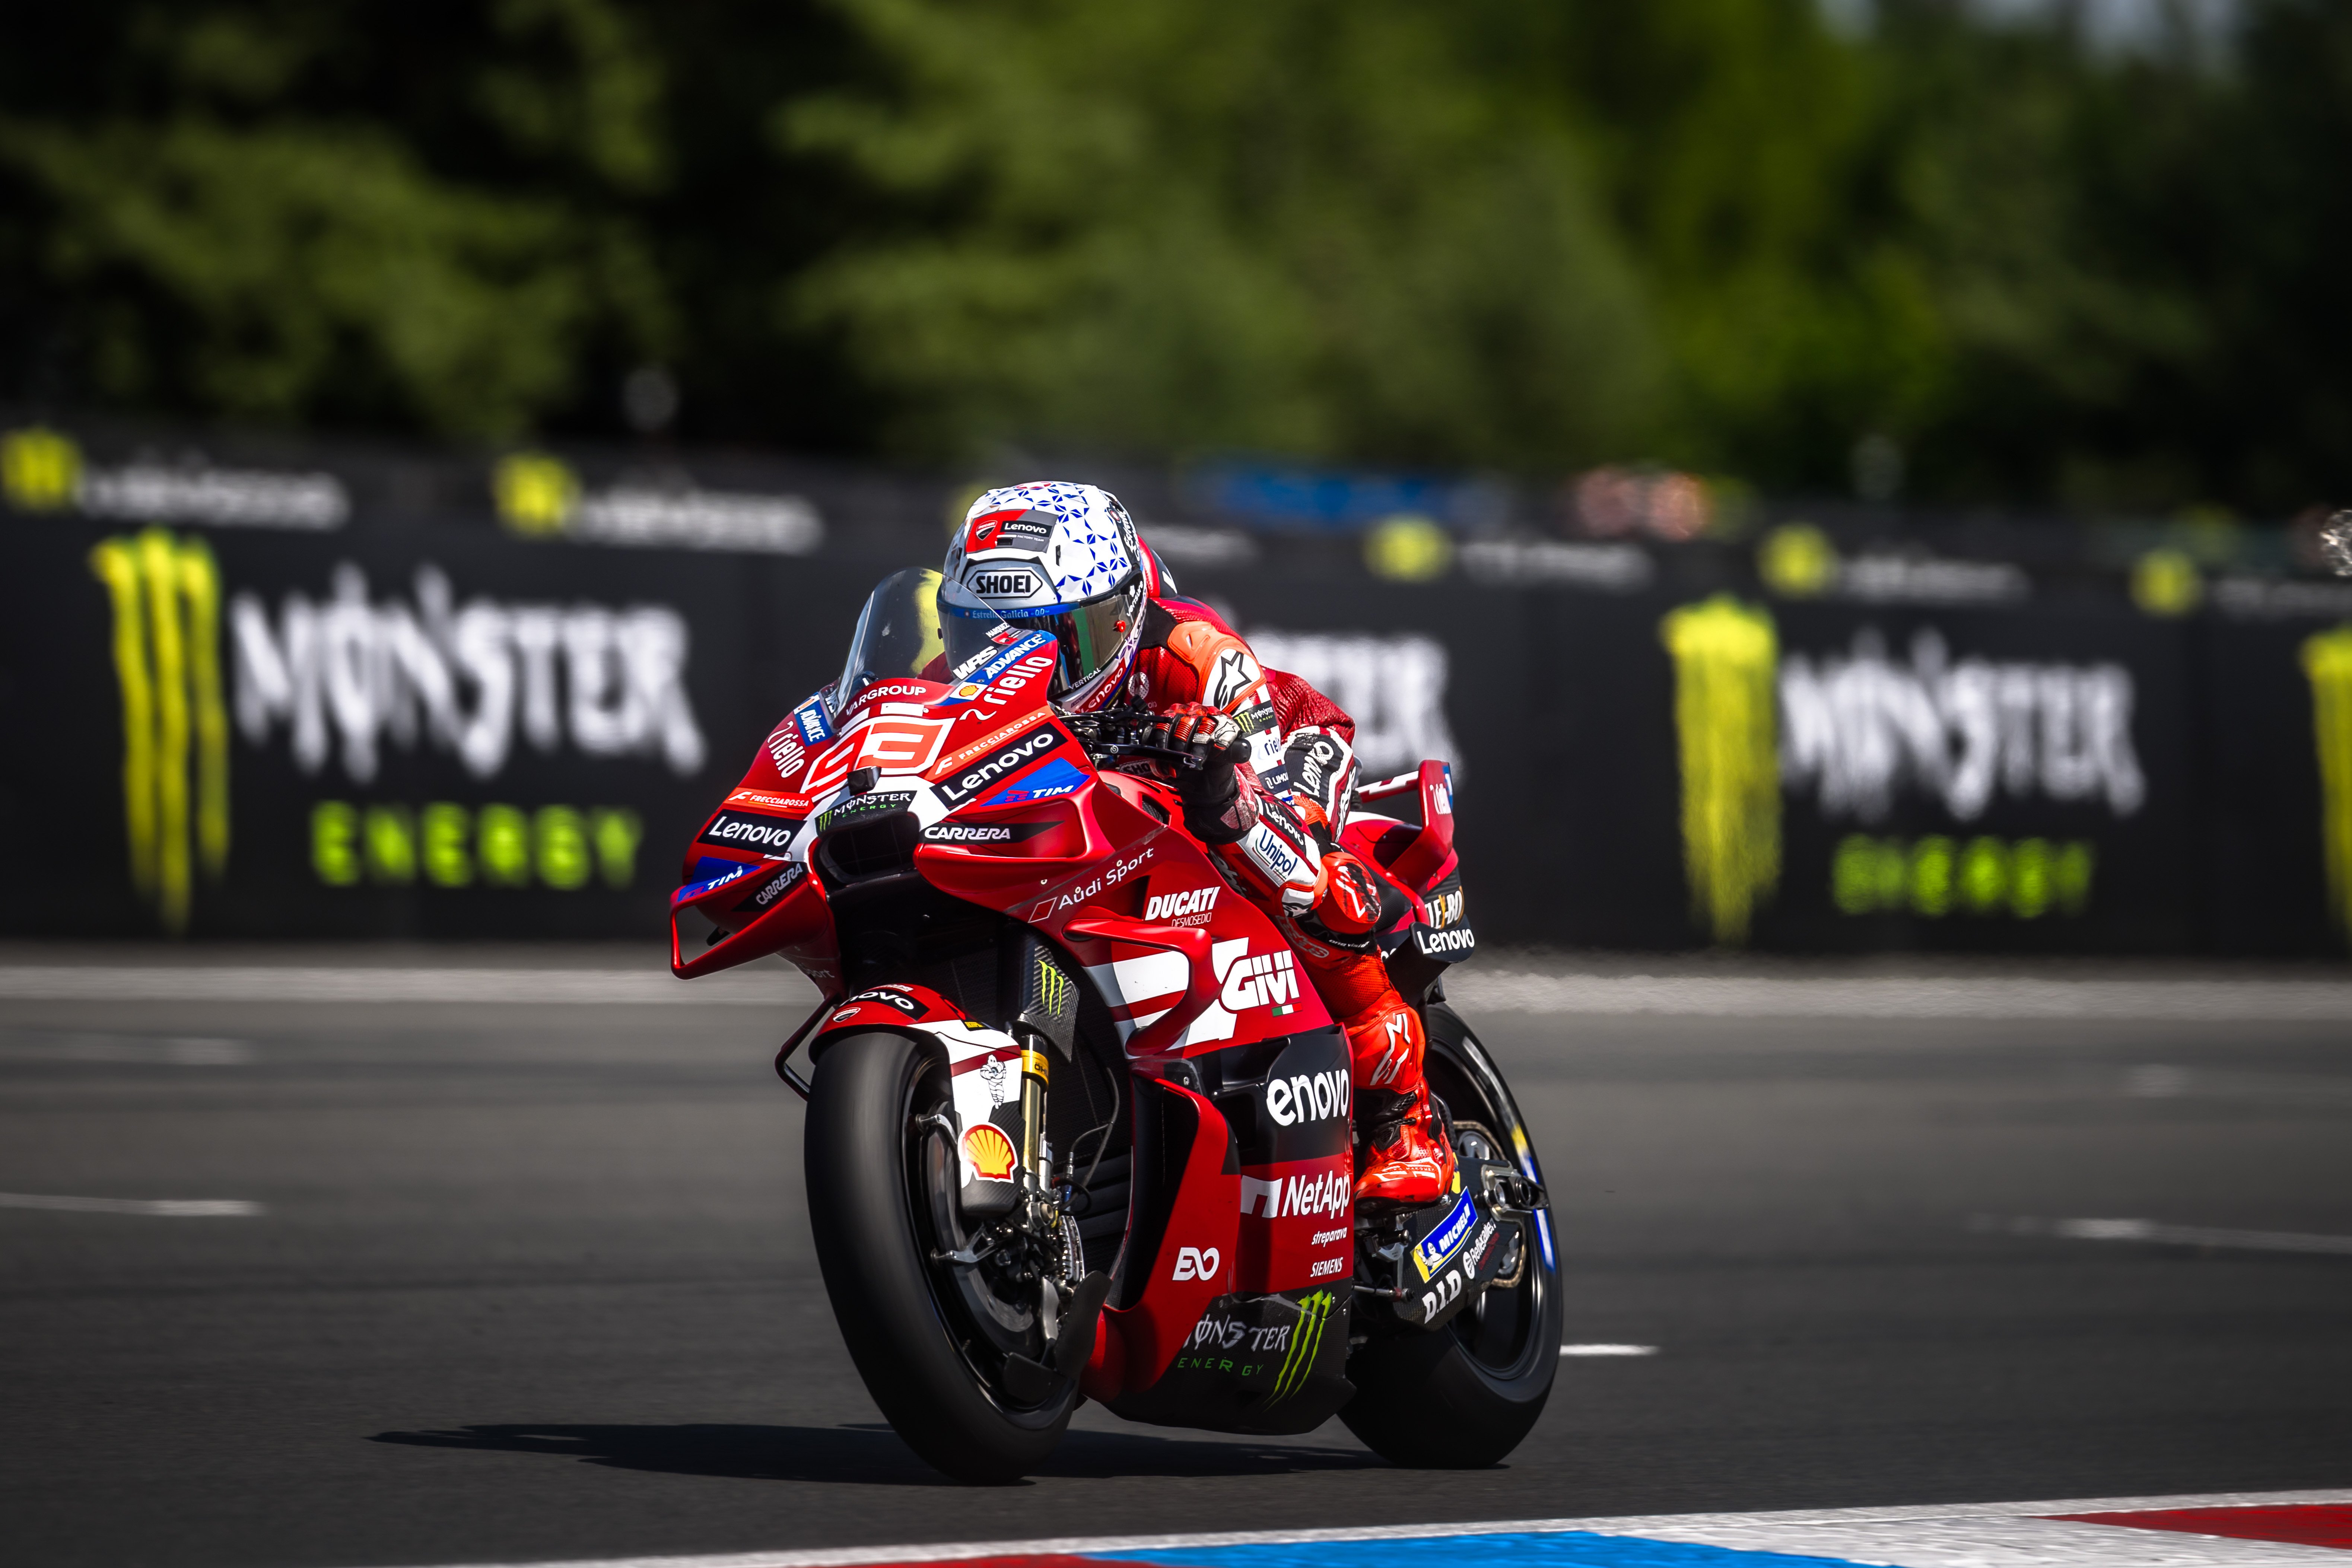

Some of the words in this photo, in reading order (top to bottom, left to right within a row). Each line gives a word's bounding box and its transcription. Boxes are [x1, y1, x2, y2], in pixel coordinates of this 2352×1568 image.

[1004, 523, 1047, 534] Lenovo
[976, 575, 1030, 594] SHOEI
[1000, 610, 1029, 618] Galicia
[986, 622, 1010, 638] MARQUEZ
[954, 646, 997, 680] WRS
[986, 633, 1046, 679] ADVANCE
[983, 656, 1053, 705] riello
[1068, 667, 1101, 689] VERTICAL
[800, 709, 825, 742] ADVANCE
[958, 711, 1046, 760] FRECCIAROSSA
[769, 733, 805, 778] riello
[941, 733, 1054, 801] Lenovo
[749, 795, 809, 808] FRECCIAROSSA
[834, 793, 911, 816] MONSTER
[1033, 785, 1074, 799] TIM
[842, 803, 897, 818] ENERGY
[709, 816, 791, 846] Lenovo
[924, 827, 1011, 840] CARRERA
[1259, 828, 1298, 876] Unipol
[708, 866, 743, 890] TIM
[756, 863, 803, 905] CARRERA
[1058, 877, 1102, 910] Audi
[1106, 847, 1154, 884] Sport
[1145, 886, 1221, 920] DUCATI
[1172, 912, 1212, 928] DESMOSEDICI
[1417, 929, 1475, 954] Lenovo
[1221, 950, 1300, 1010] GIVI
[1266, 1068, 1349, 1126] enovo
[1281, 1170, 1350, 1219] NetApp
[1311, 1227, 1347, 1247] streparava
[1310, 1257, 1343, 1277] SIEMENS
[1177, 1357, 1264, 1376] ENERGY
